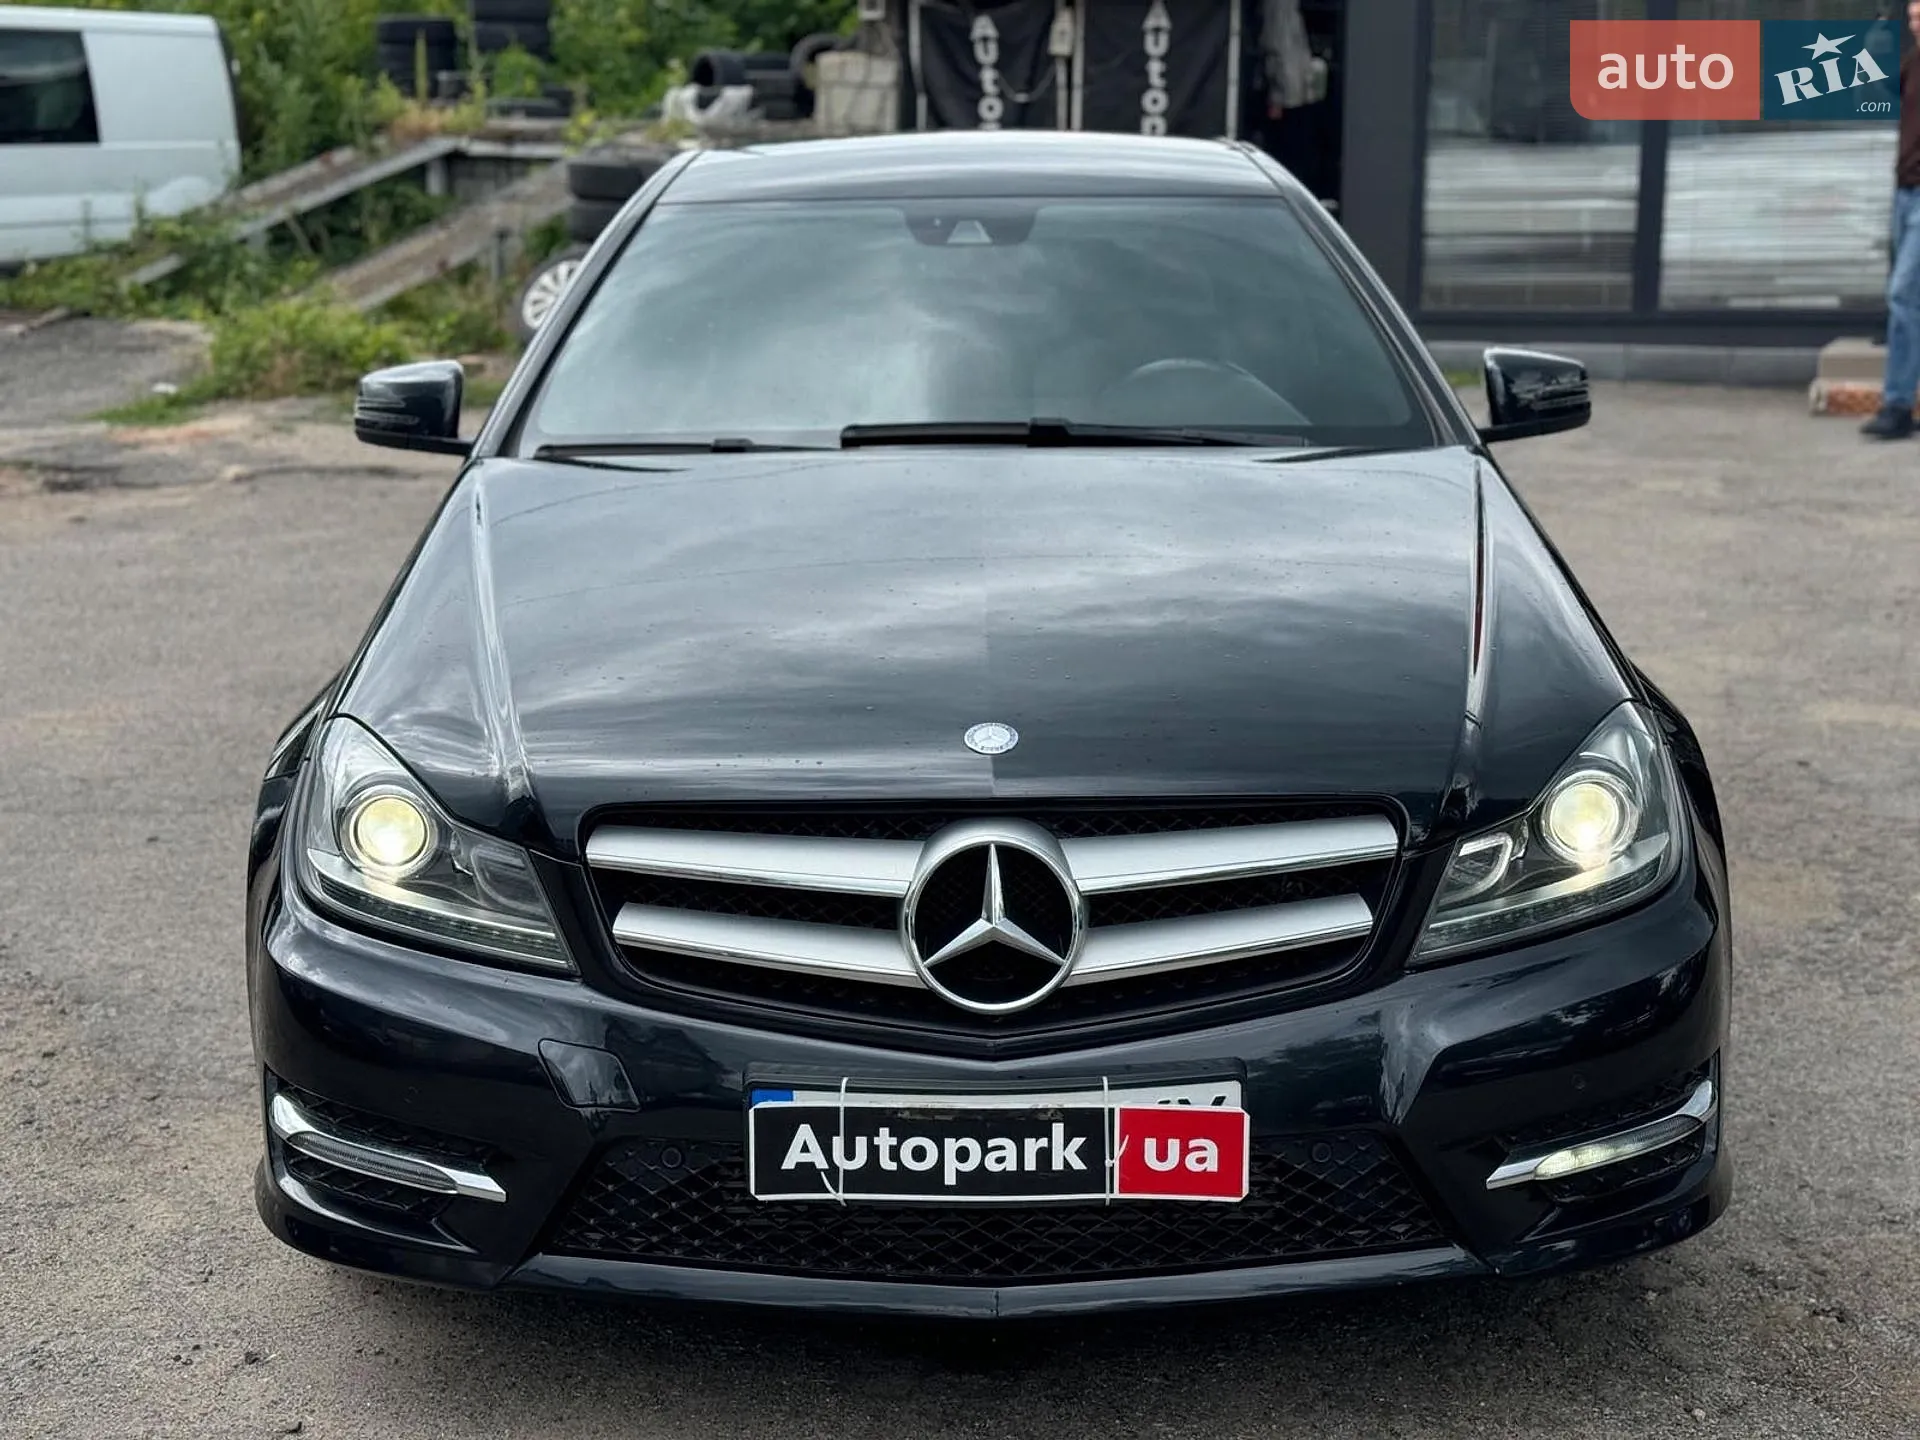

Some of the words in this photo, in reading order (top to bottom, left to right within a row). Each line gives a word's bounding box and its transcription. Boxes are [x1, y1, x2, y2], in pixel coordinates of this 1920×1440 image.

[970, 14, 1004, 130] Auto
[781, 1122, 1087, 1186] Autopark
[1144, 1137, 1219, 1172] ua
